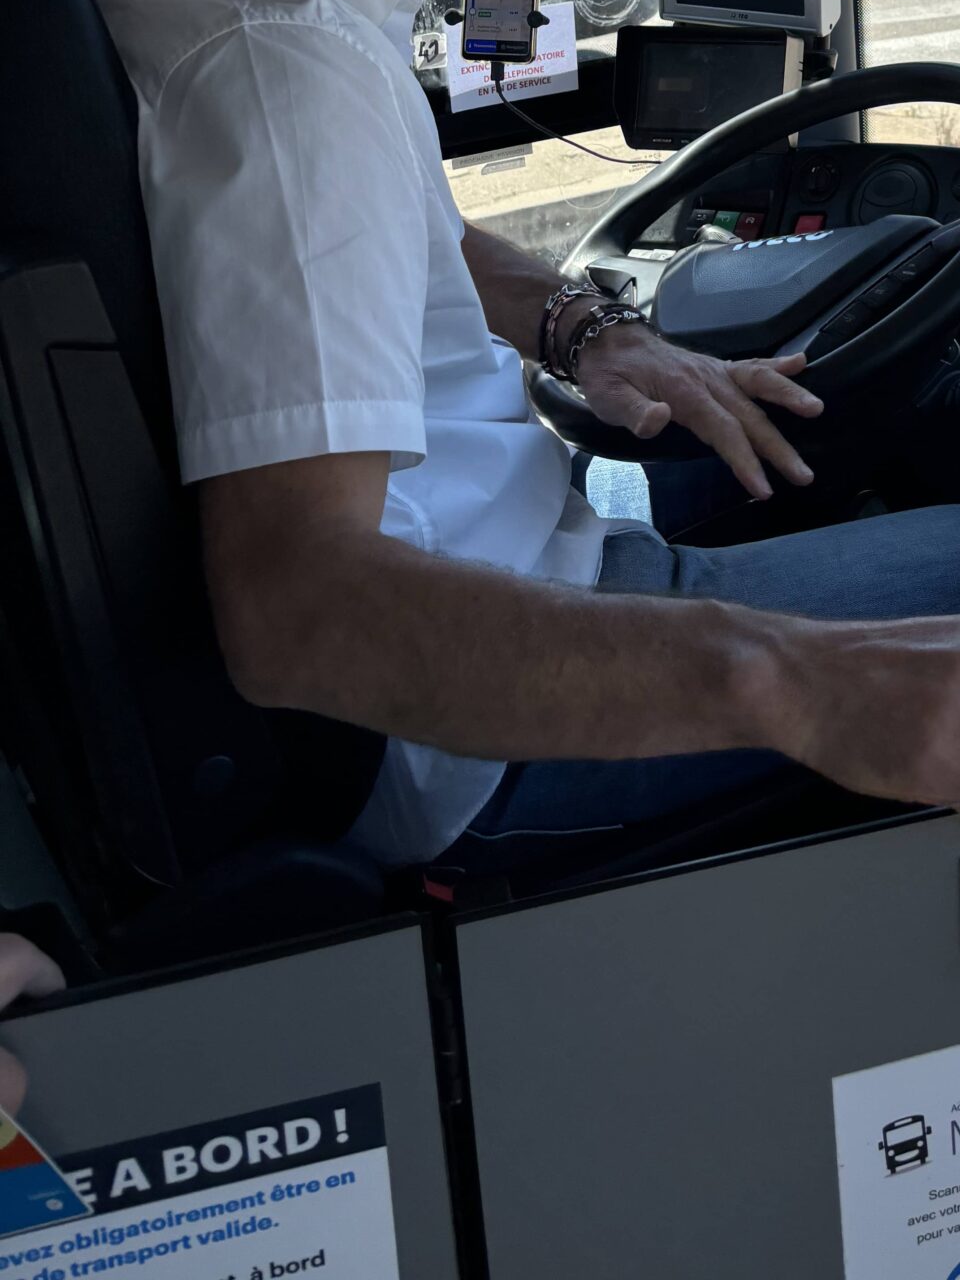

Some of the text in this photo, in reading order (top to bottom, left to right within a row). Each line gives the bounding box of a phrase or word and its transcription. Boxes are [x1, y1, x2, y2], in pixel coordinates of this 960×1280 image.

[478, 87, 490, 96] EN
[507, 83, 518, 91] DE
[519, 76, 552, 89] SERVICE
[109, 1157, 152, 1199] A
[162, 1117, 322, 1185] BORD
[59, 1191, 267, 1255] obligatoirement
[270, 1179, 321, 1203] être
[325, 1171, 356, 1189] en
[907, 1210, 937, 1227] avec
[70, 1234, 193, 1278] transport
[196, 1216, 280, 1246] valide.
[916, 1229, 944, 1246] pour
[270, 1249, 327, 1279] bord
